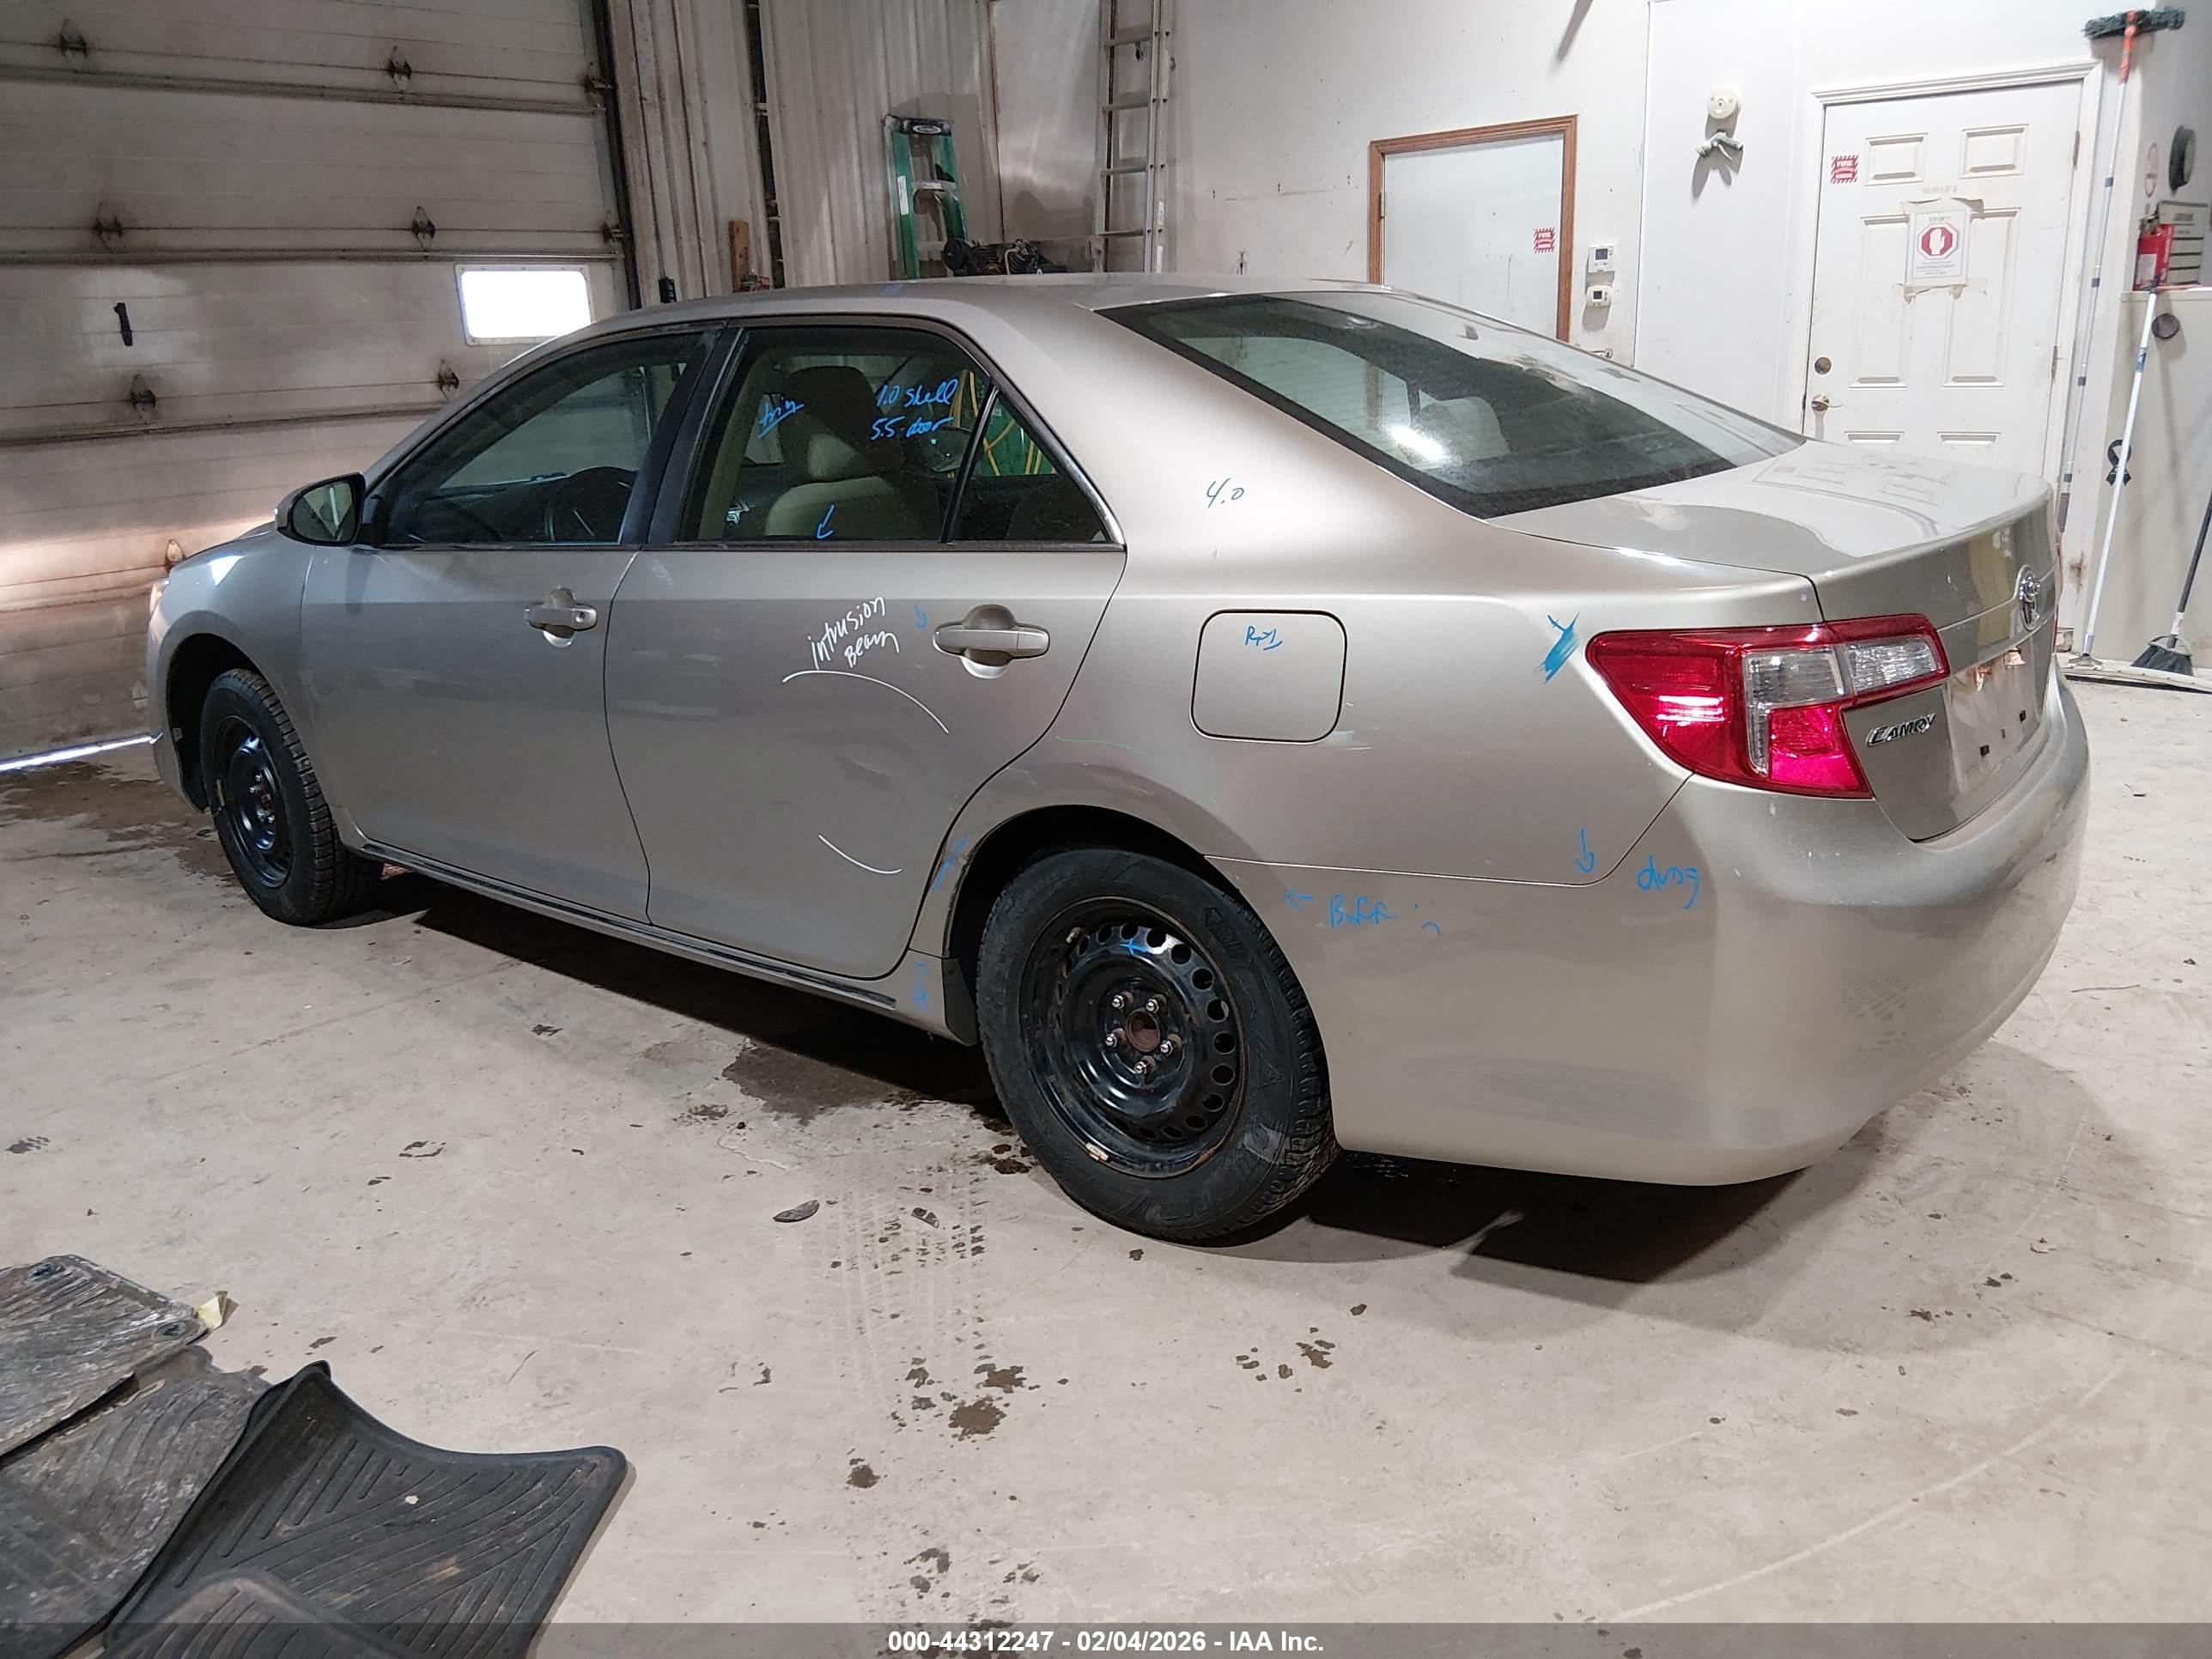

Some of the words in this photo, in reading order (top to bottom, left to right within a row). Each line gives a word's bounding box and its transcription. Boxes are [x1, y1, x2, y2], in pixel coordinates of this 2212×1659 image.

[1206, 478, 1244, 508] 4.0
[807, 597, 885, 670] intrusion
[844, 631, 900, 668] Beam
[1865, 714, 1936, 746] CAMRY
